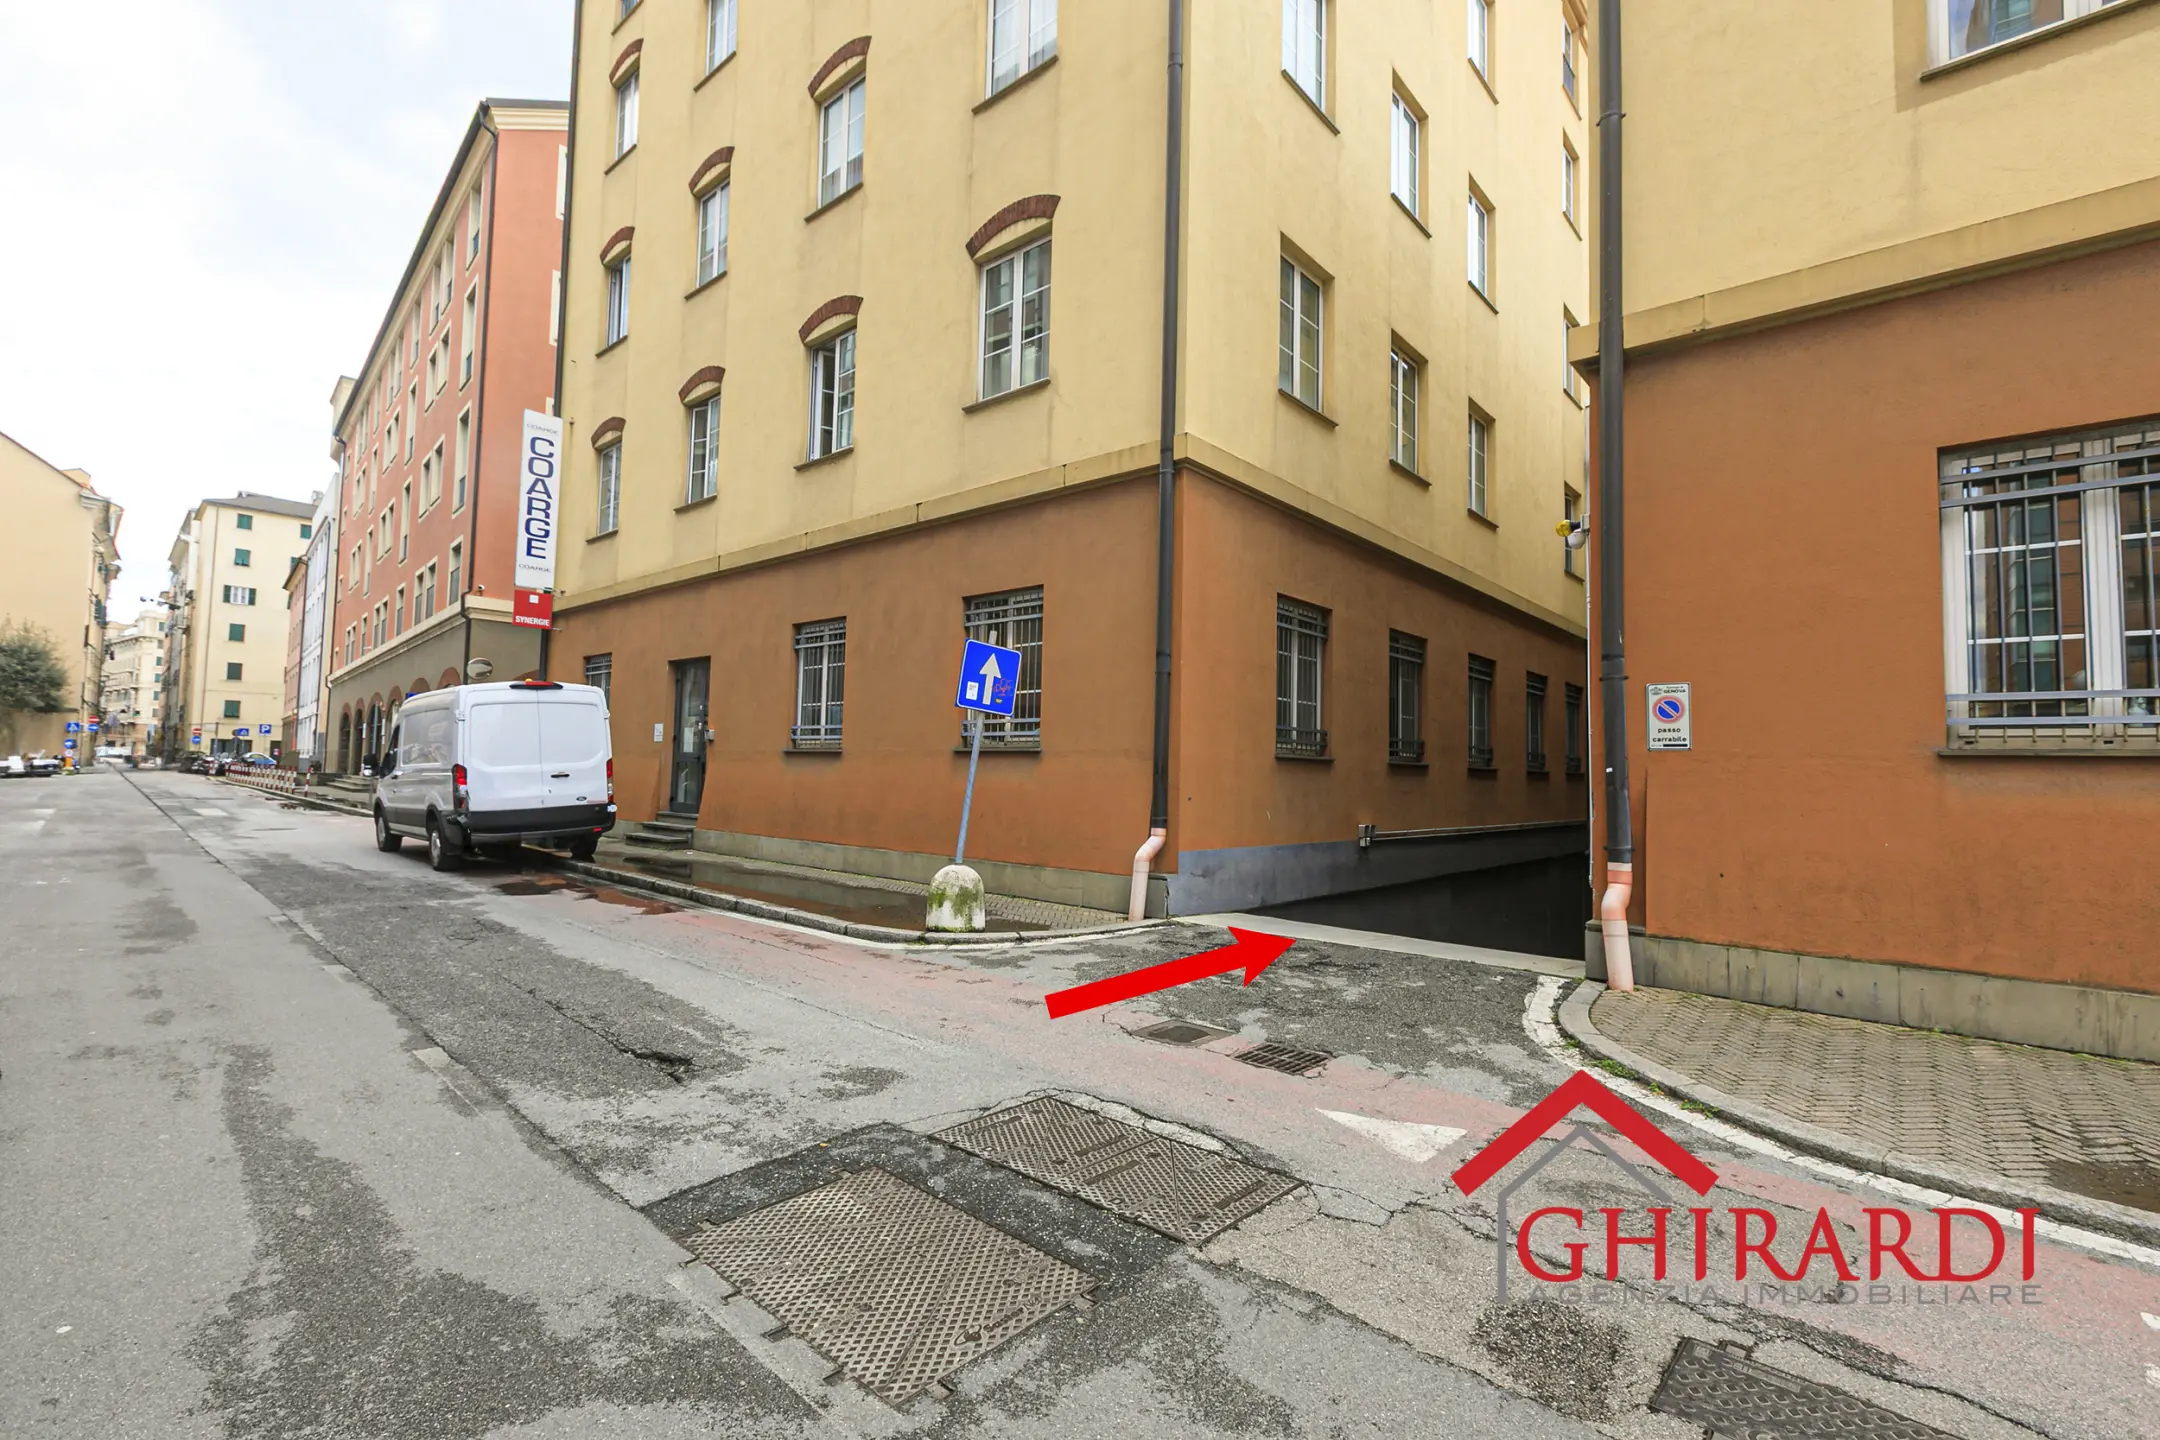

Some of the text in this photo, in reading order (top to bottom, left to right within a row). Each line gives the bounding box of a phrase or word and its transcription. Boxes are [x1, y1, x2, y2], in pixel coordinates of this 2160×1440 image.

[525, 436, 555, 560] COARGE
[518, 563, 552, 573] COARGE
[515, 615, 550, 627] SYNERGIE
[261, 725, 270, 733] P
